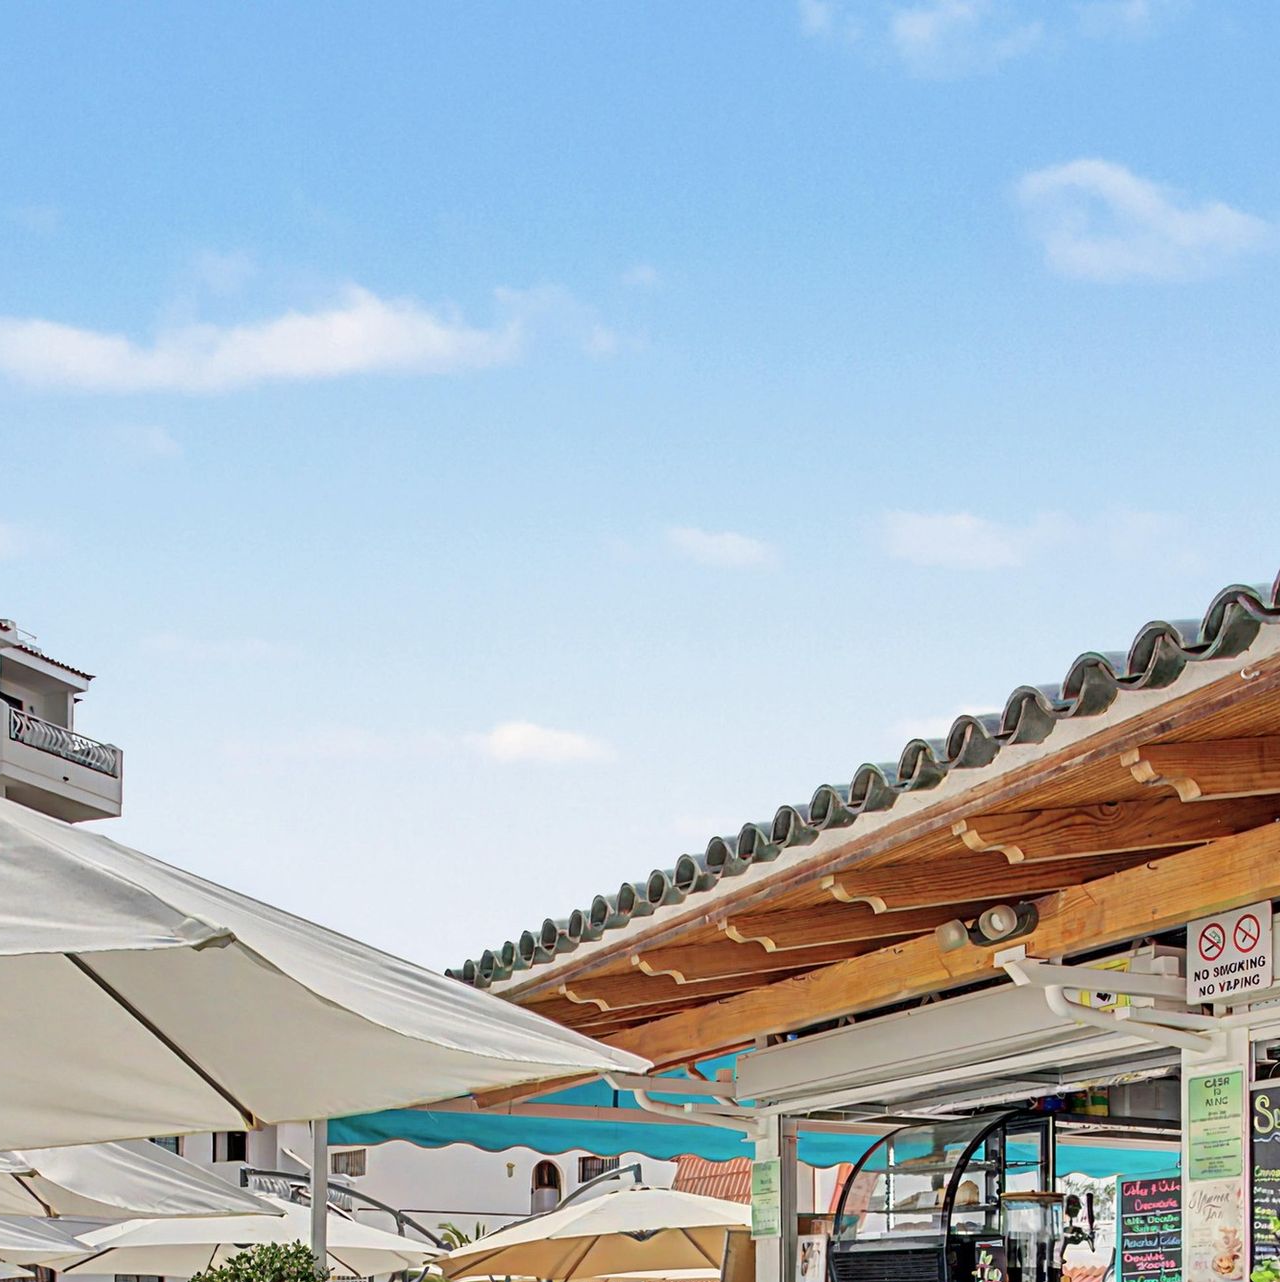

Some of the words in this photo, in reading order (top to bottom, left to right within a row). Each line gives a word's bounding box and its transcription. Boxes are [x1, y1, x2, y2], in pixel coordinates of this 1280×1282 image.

[1194, 969, 1209, 982] NO
[1213, 955, 1266, 978] SMOKING
[1199, 984, 1215, 997] NO
[1219, 974, 1260, 992] VAPING
